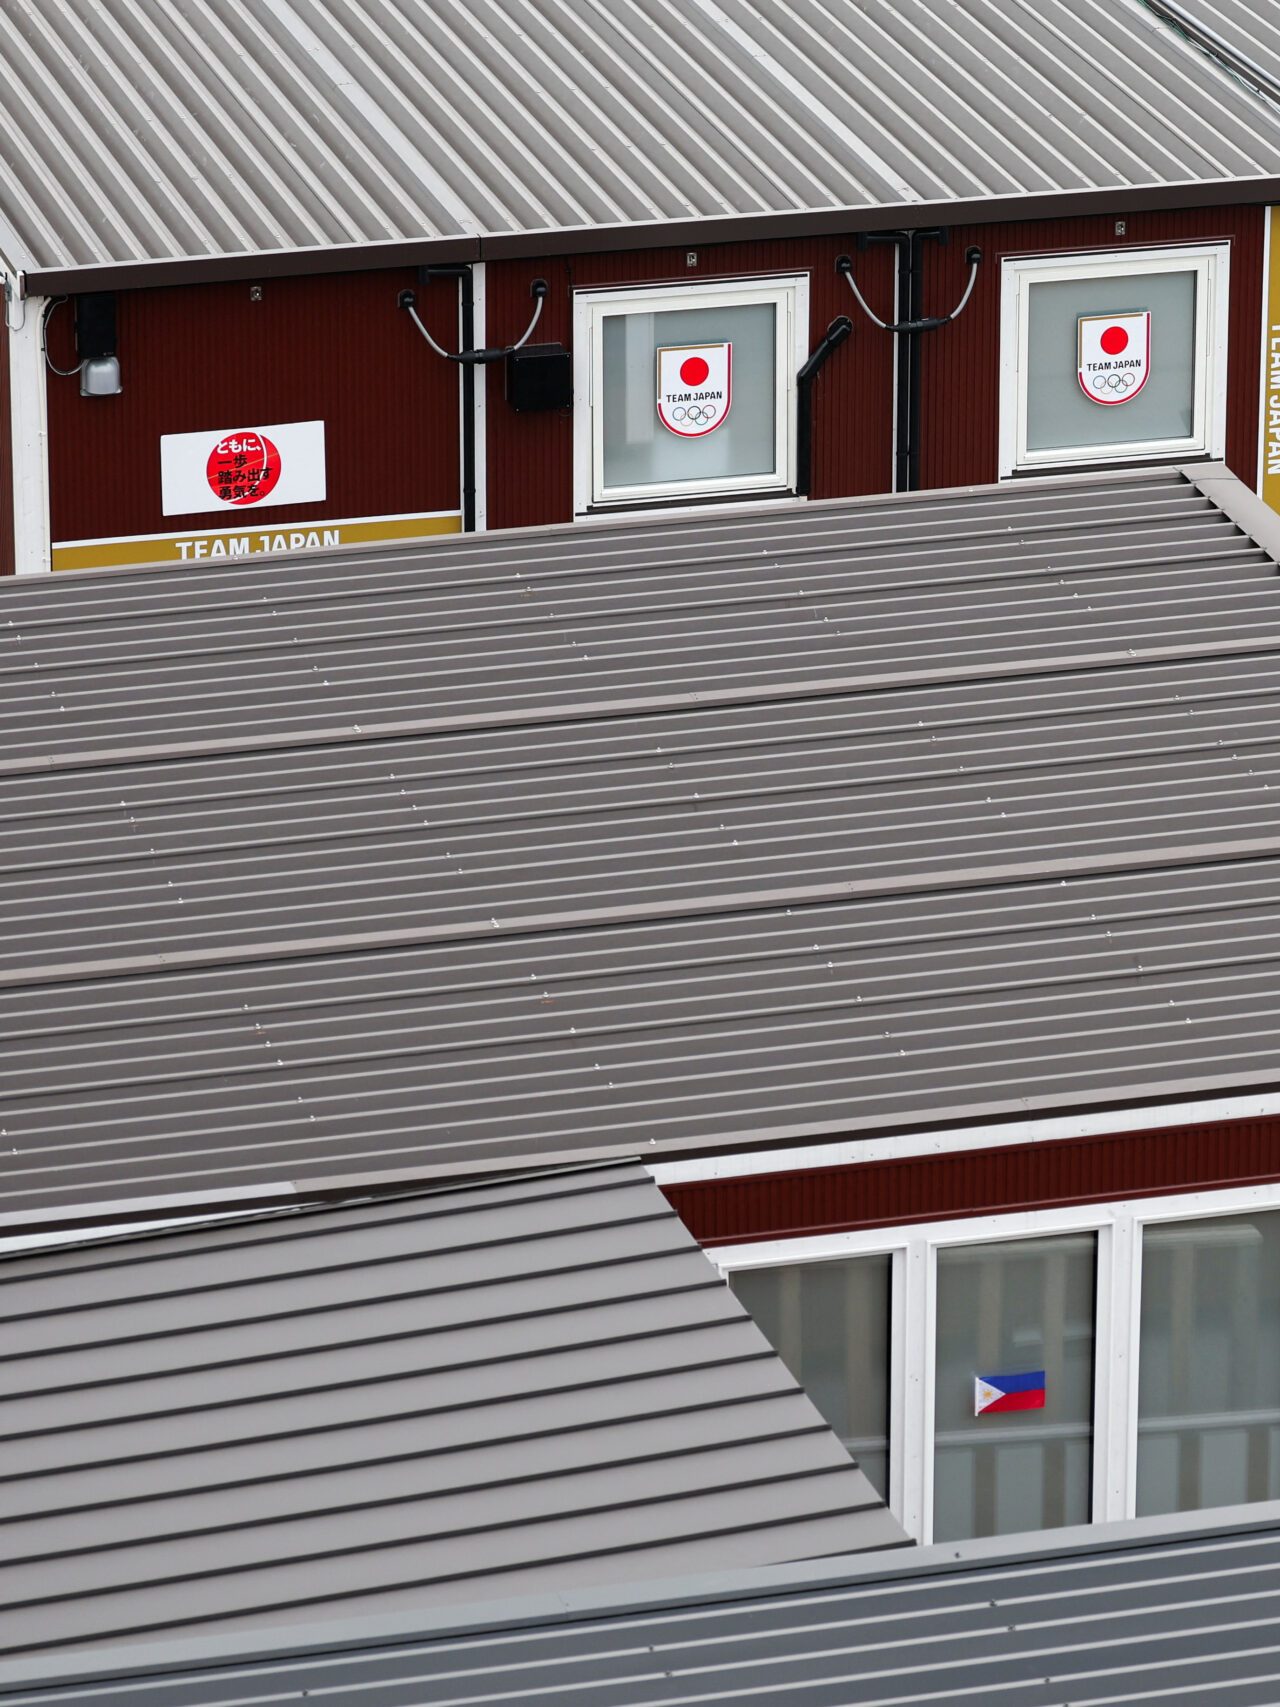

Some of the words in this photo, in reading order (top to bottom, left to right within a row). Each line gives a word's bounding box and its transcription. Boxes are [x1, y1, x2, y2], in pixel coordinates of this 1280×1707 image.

[1087, 362, 1111, 371] TEAM
[1113, 359, 1141, 369] JAPAN
[666, 393, 691, 403] TEAM
[693, 391, 722, 401] JAPAN
[217, 439, 261, 454] ともに、
[218, 454, 247, 468] 一歩
[218, 467, 272, 484] 踏み出す
[175, 537, 250, 560] TEAM
[255, 530, 340, 553] JAPAN
